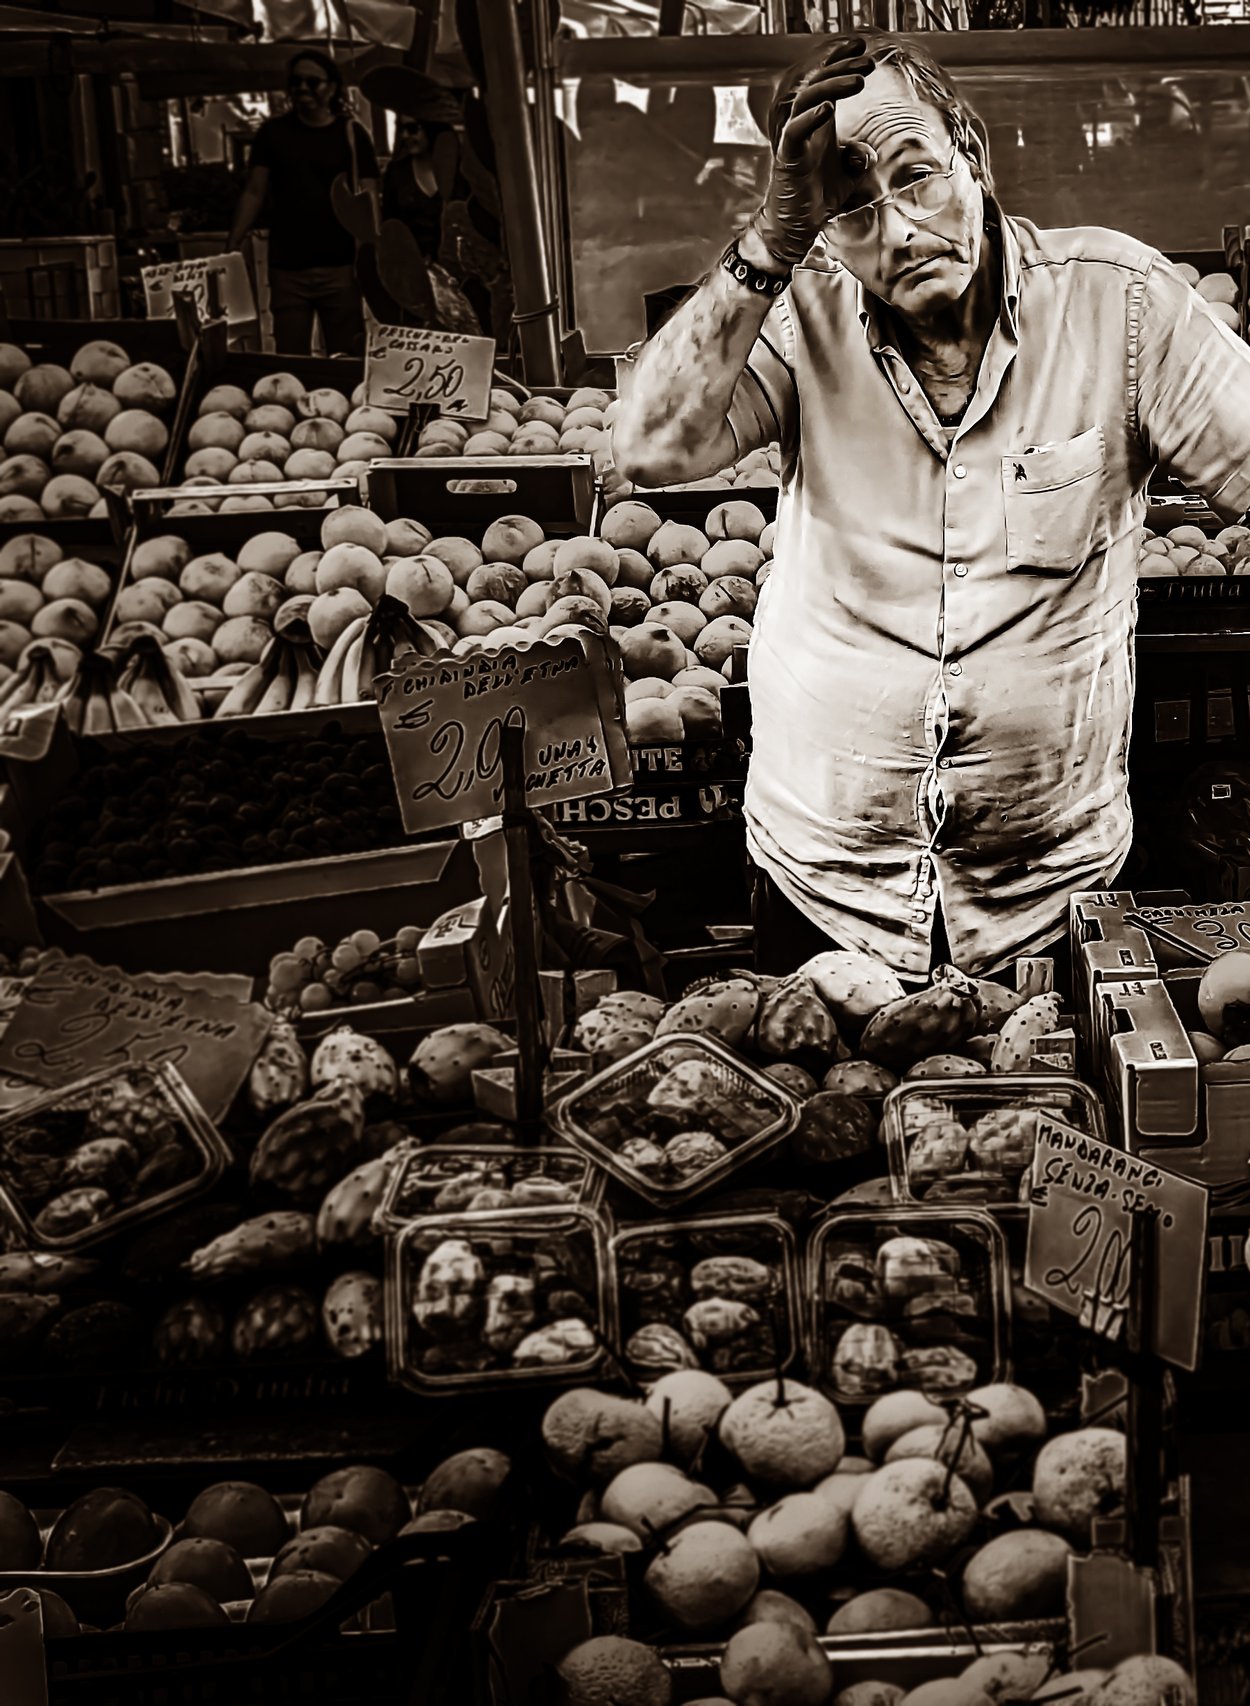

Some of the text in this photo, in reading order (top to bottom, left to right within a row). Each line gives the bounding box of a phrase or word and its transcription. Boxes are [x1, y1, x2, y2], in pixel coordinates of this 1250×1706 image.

[383, 357, 464, 401] 2,50
[1163, 580, 1241, 599] Frutta
[1037, 1123, 1163, 1188] MANDARANCI
